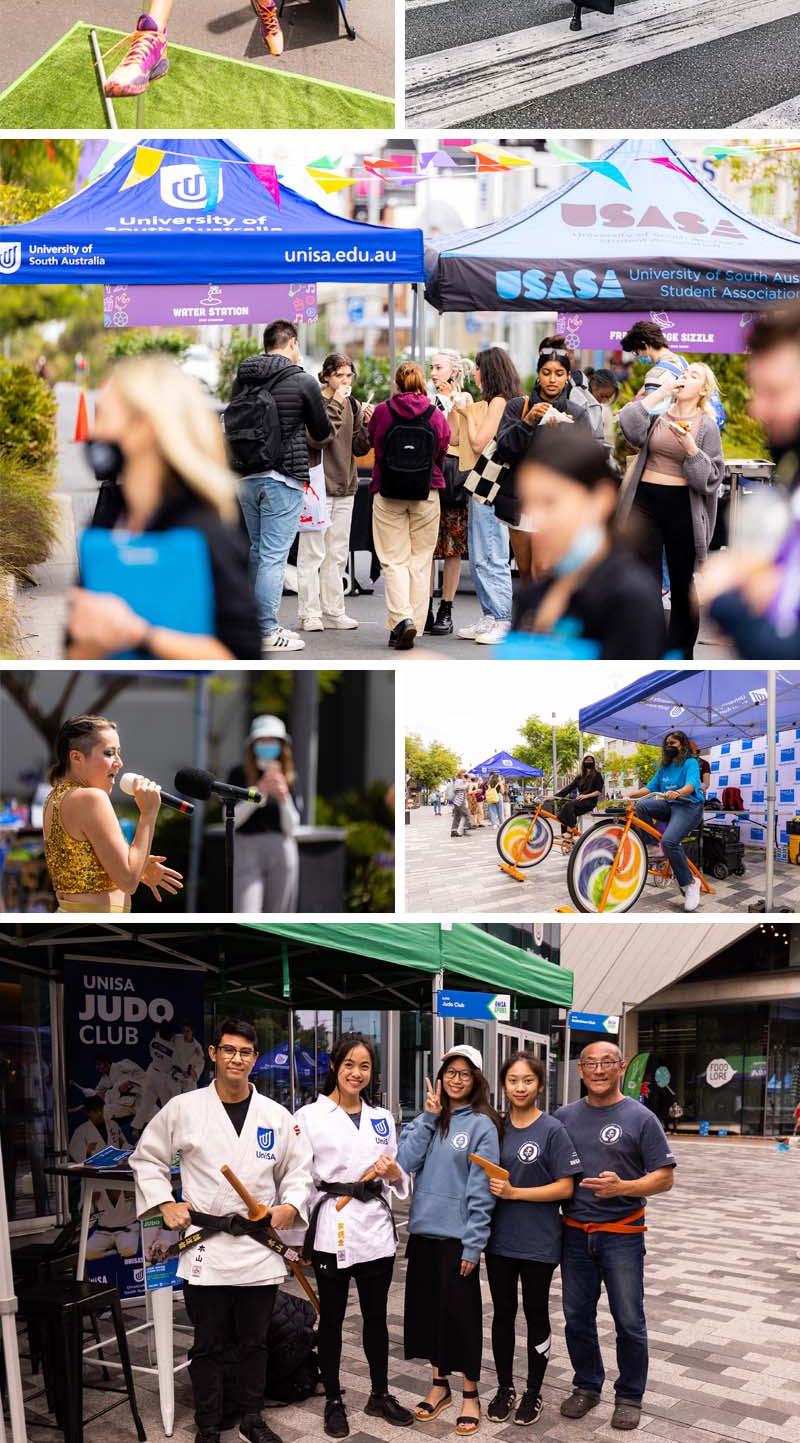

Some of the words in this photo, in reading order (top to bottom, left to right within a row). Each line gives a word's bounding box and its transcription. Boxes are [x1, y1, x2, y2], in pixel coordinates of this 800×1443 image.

[119, 215, 236, 227] University
[242, 215, 267, 224] of
[560, 203, 749, 240] USASA
[29, 244, 80, 255] University
[82, 244, 93, 254] of
[284, 247, 397, 262] unisa.edu.au
[29, 256, 58, 266] South
[61, 256, 105, 266] Australia
[495, 268, 625, 300] USASA
[629, 268, 700, 282] University
[704, 268, 723, 280] of
[725, 270, 767, 283] South
[660, 285, 717, 298] Student
[173, 308, 206, 316] WATER
[208, 306, 249, 316] STATION
[681, 333, 714, 343] SIZZLE
[83, 975, 135, 992] UNISA
[79, 994, 174, 1024] JUDO
[79, 1025, 139, 1045] CLUB
[710, 1063, 729, 1072] FOOD
[256, 1151, 276, 1160] UniSA
